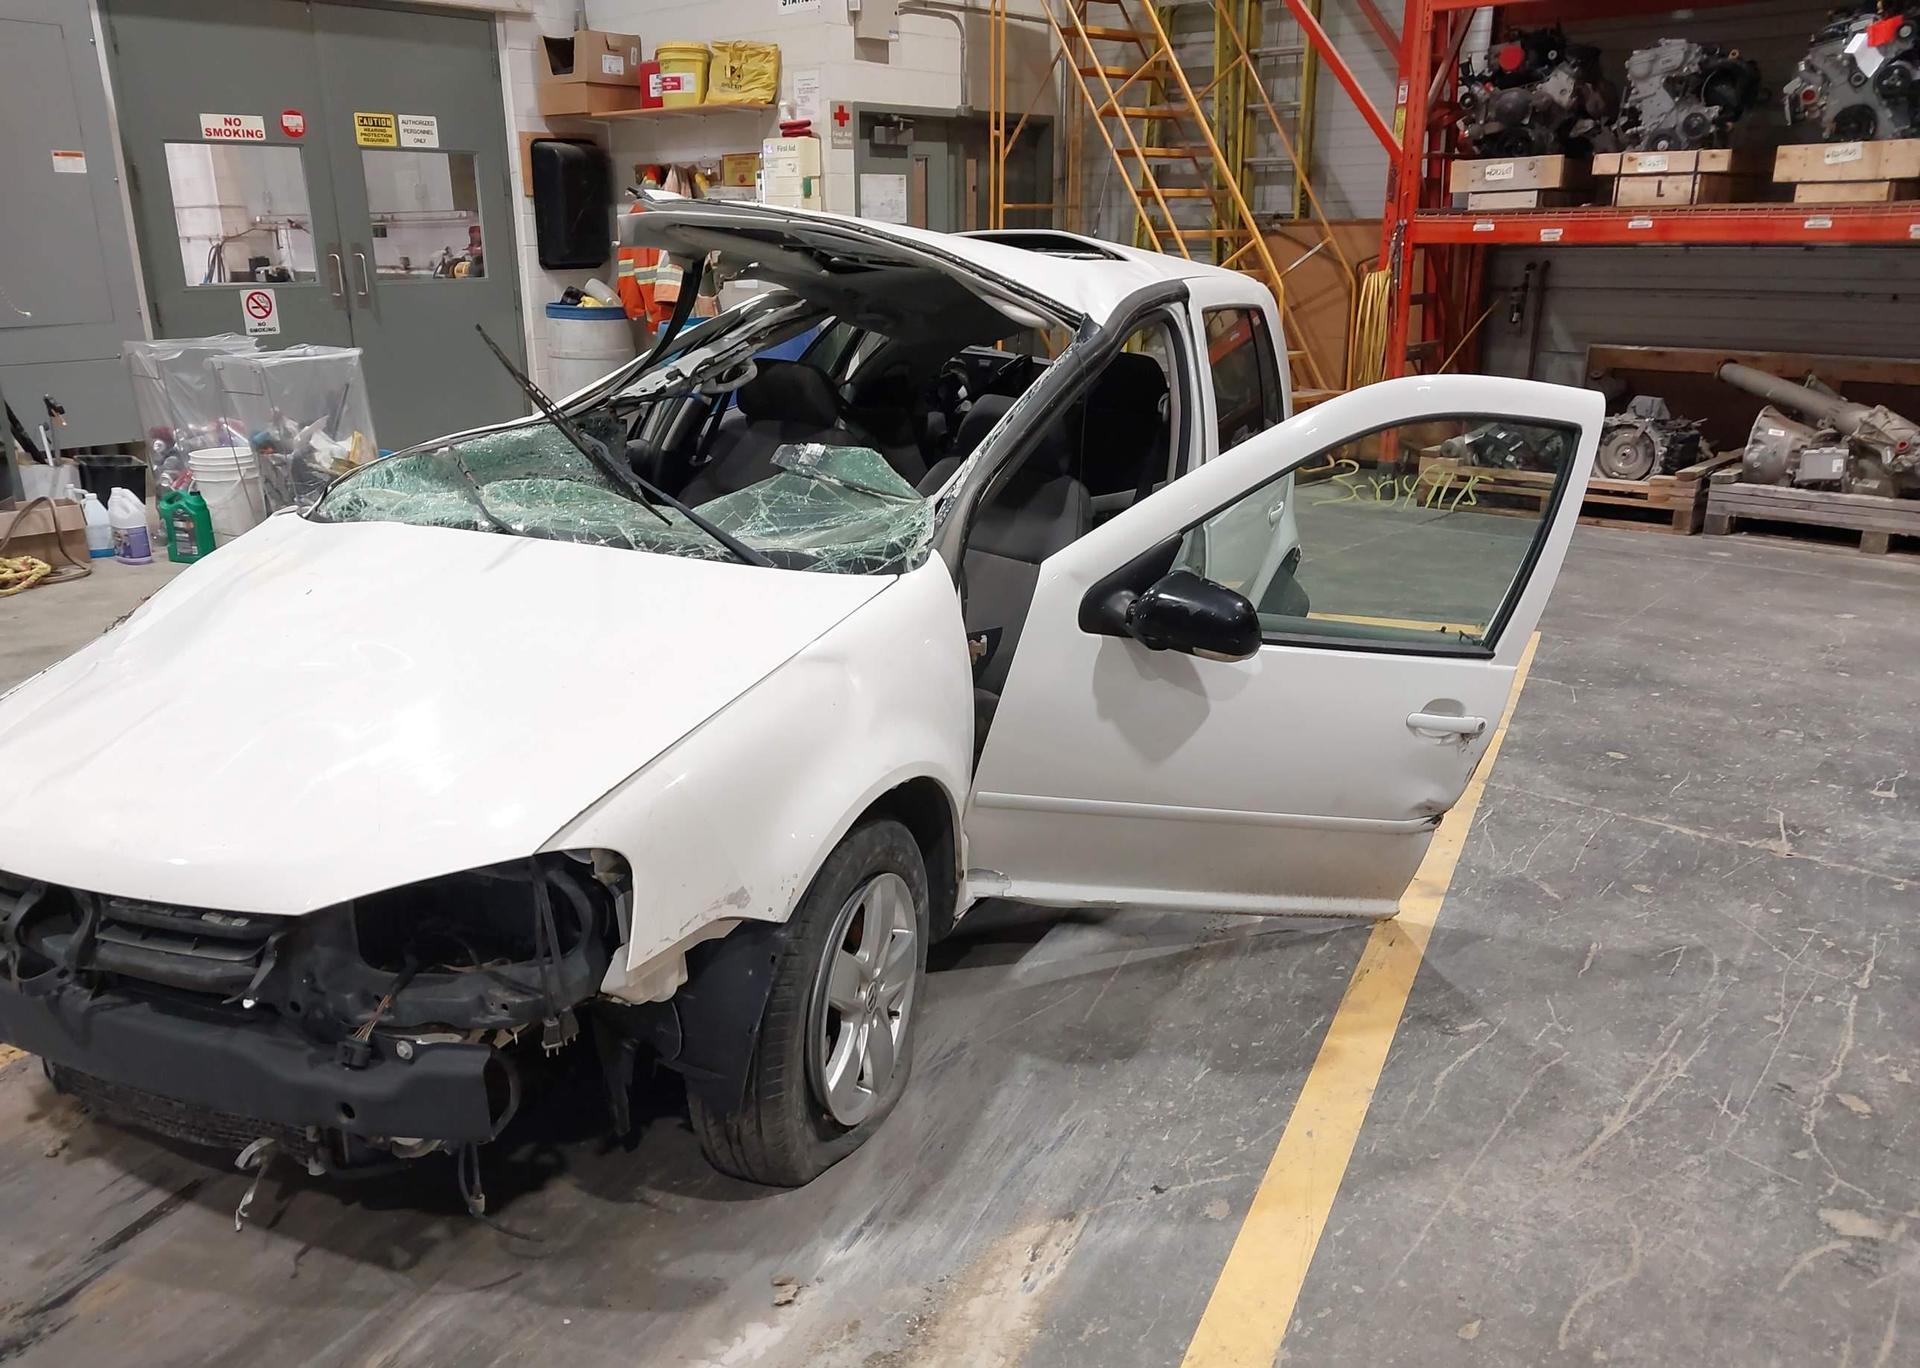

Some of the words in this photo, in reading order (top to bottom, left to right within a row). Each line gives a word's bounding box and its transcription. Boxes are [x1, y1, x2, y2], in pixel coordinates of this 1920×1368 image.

[224, 117, 242, 127] NO
[358, 117, 392, 127] CAUTION
[401, 119, 435, 127] AUTHORIZED
[205, 127, 264, 139] SMOKING
[1656, 179, 1665, 198] L
